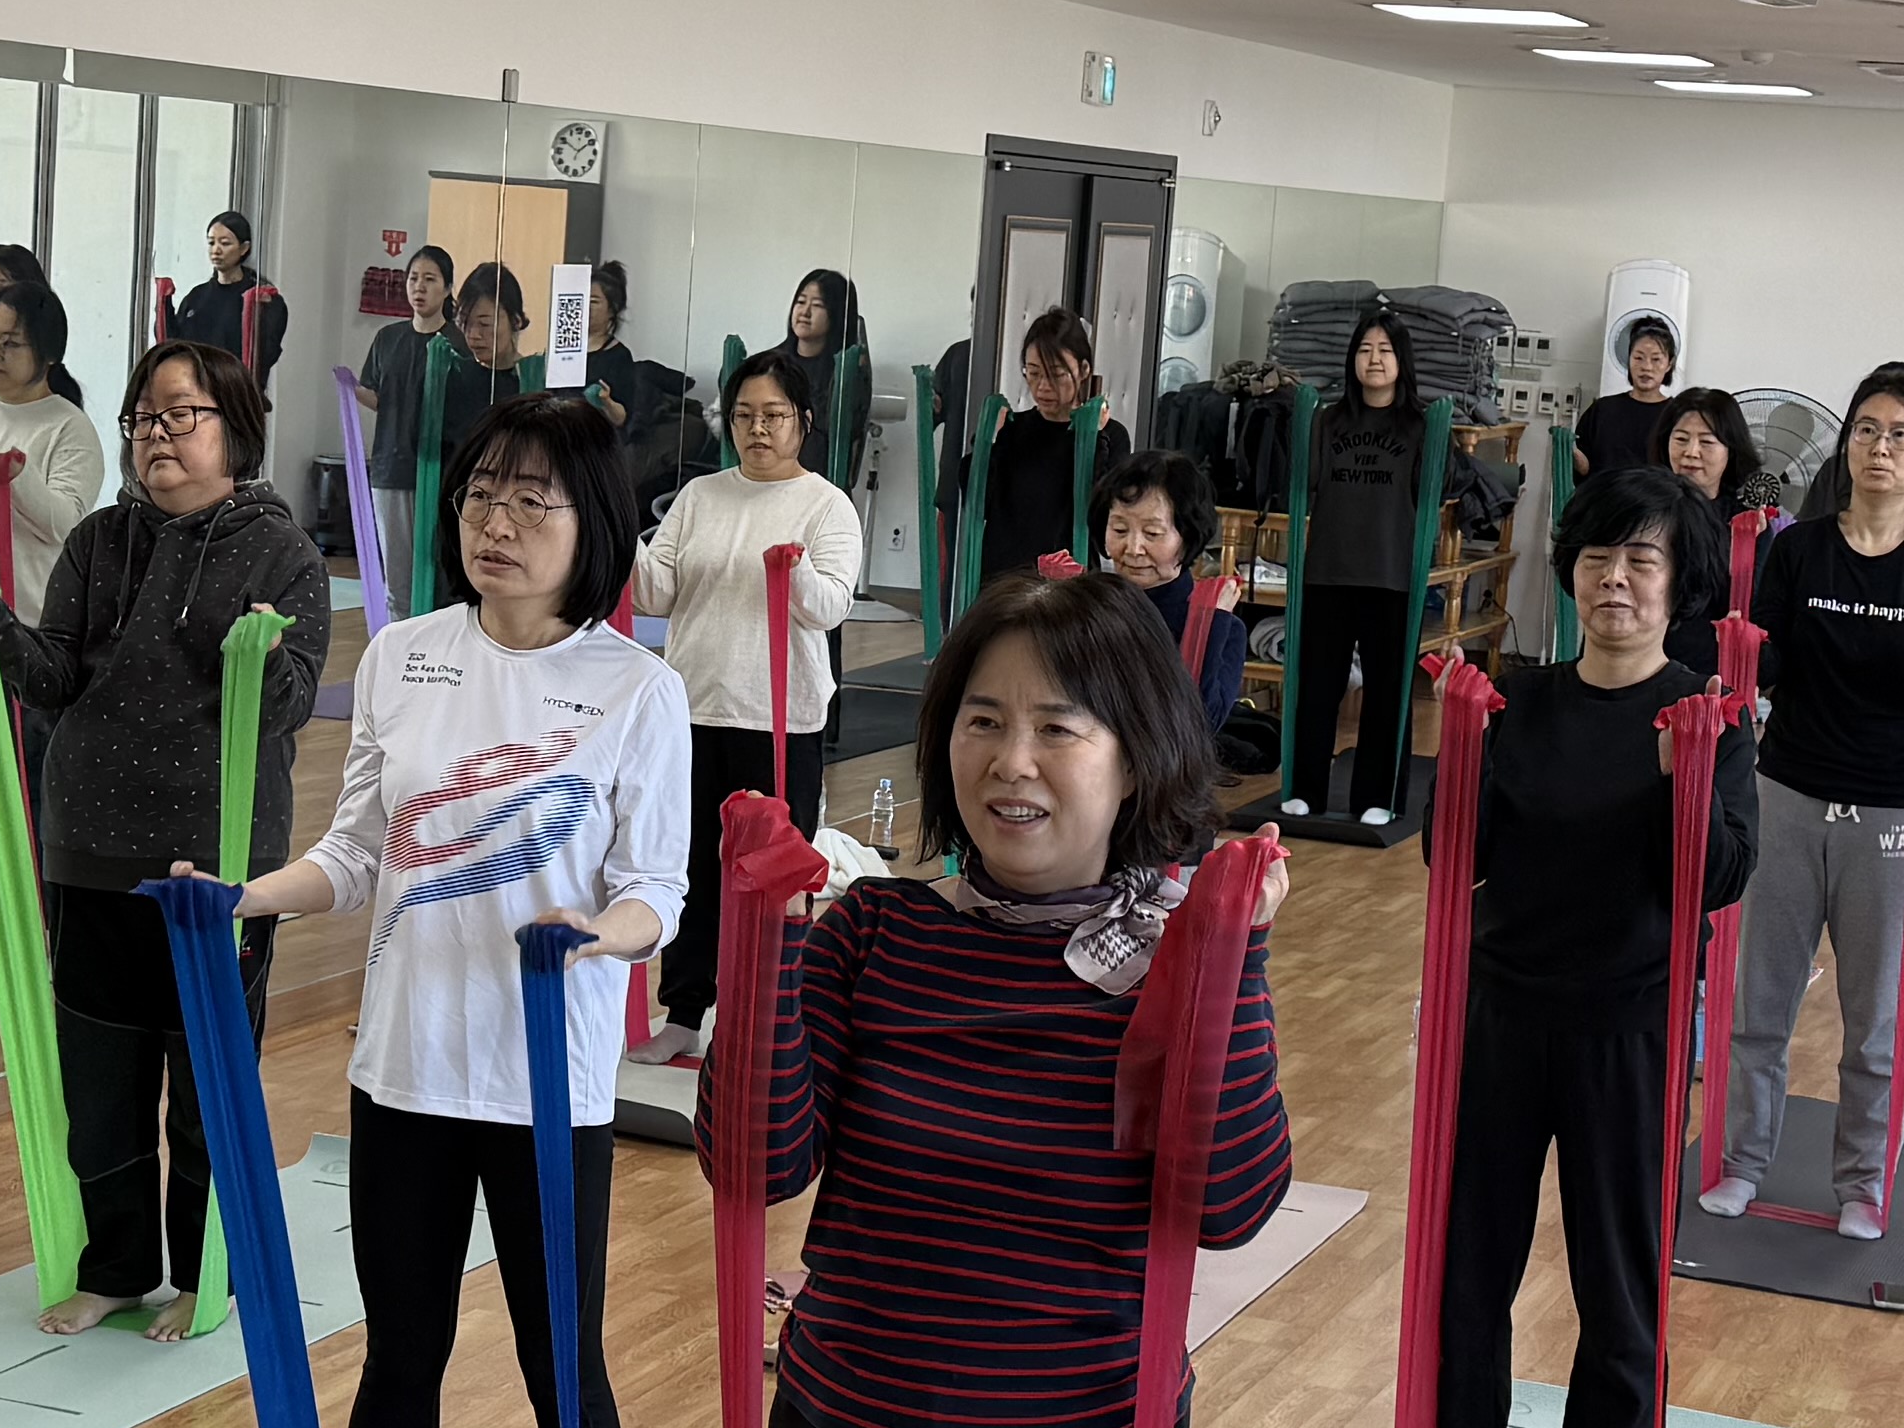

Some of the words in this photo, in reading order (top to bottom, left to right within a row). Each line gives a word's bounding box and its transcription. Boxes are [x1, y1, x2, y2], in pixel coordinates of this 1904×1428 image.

[1331, 431, 1407, 457] BROOKLYN
[1331, 468, 1361, 483] NEW
[1363, 470, 1393, 485] YORK
[1808, 597, 1851, 613] make
[1854, 603, 1866, 614] it
[542, 695, 605, 716] HYDROGEN
